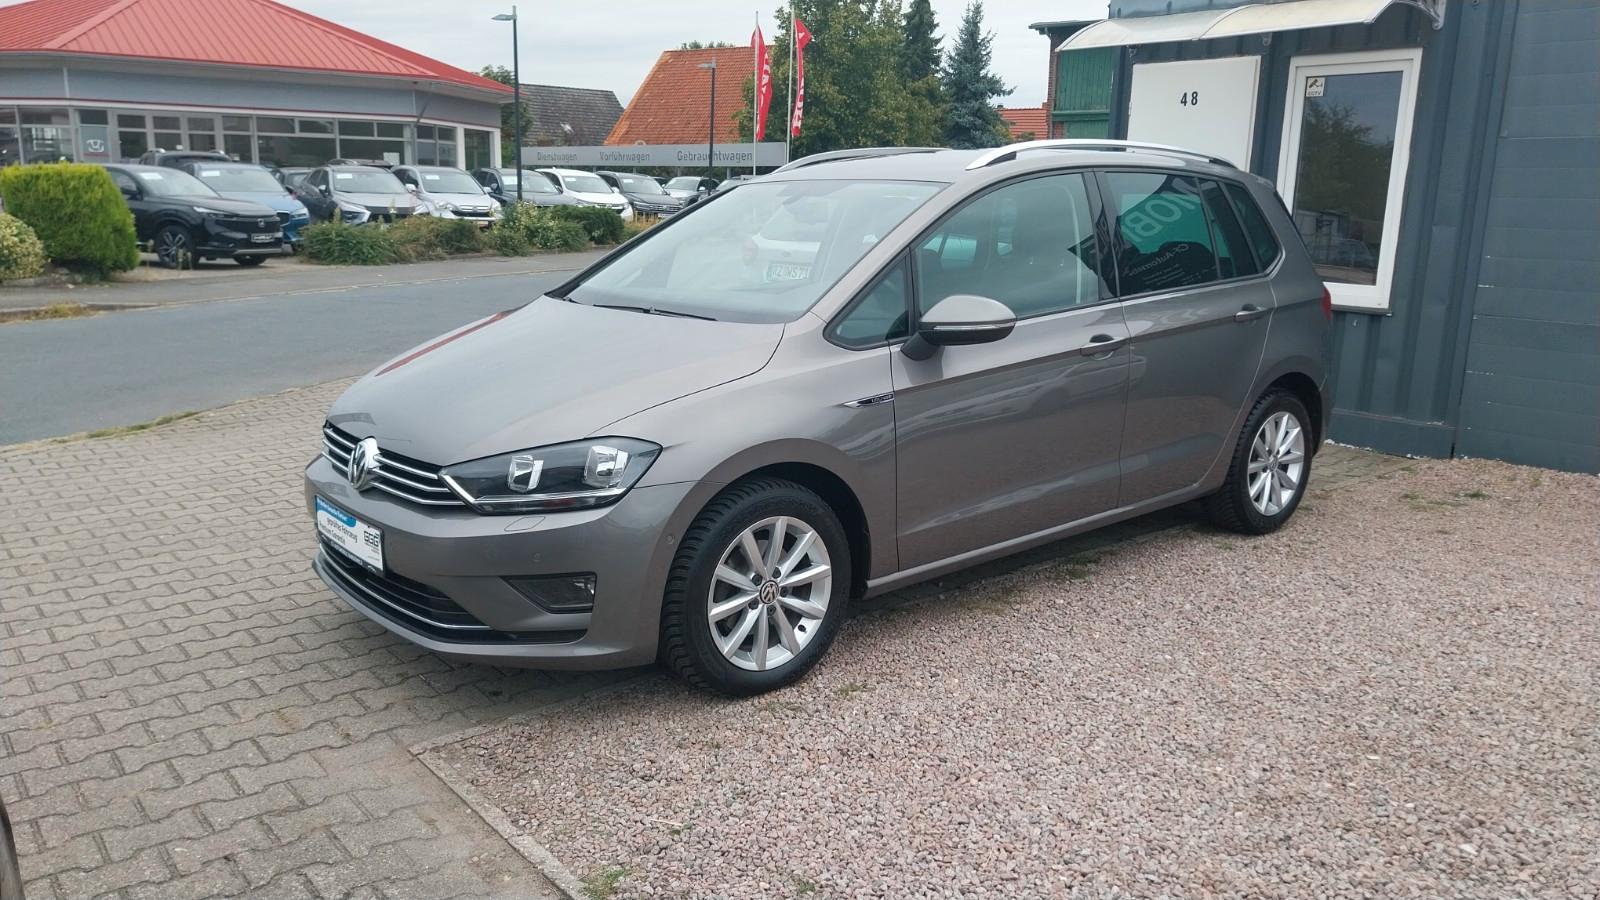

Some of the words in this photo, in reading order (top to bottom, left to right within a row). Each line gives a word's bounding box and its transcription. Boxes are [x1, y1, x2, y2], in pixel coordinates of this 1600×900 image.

[1180, 91, 1199, 106] 48
[537, 152, 578, 162] Dienstwagen
[599, 151, 650, 163] Vorführwagen
[677, 150, 753, 163] Gebrauhtwagen
